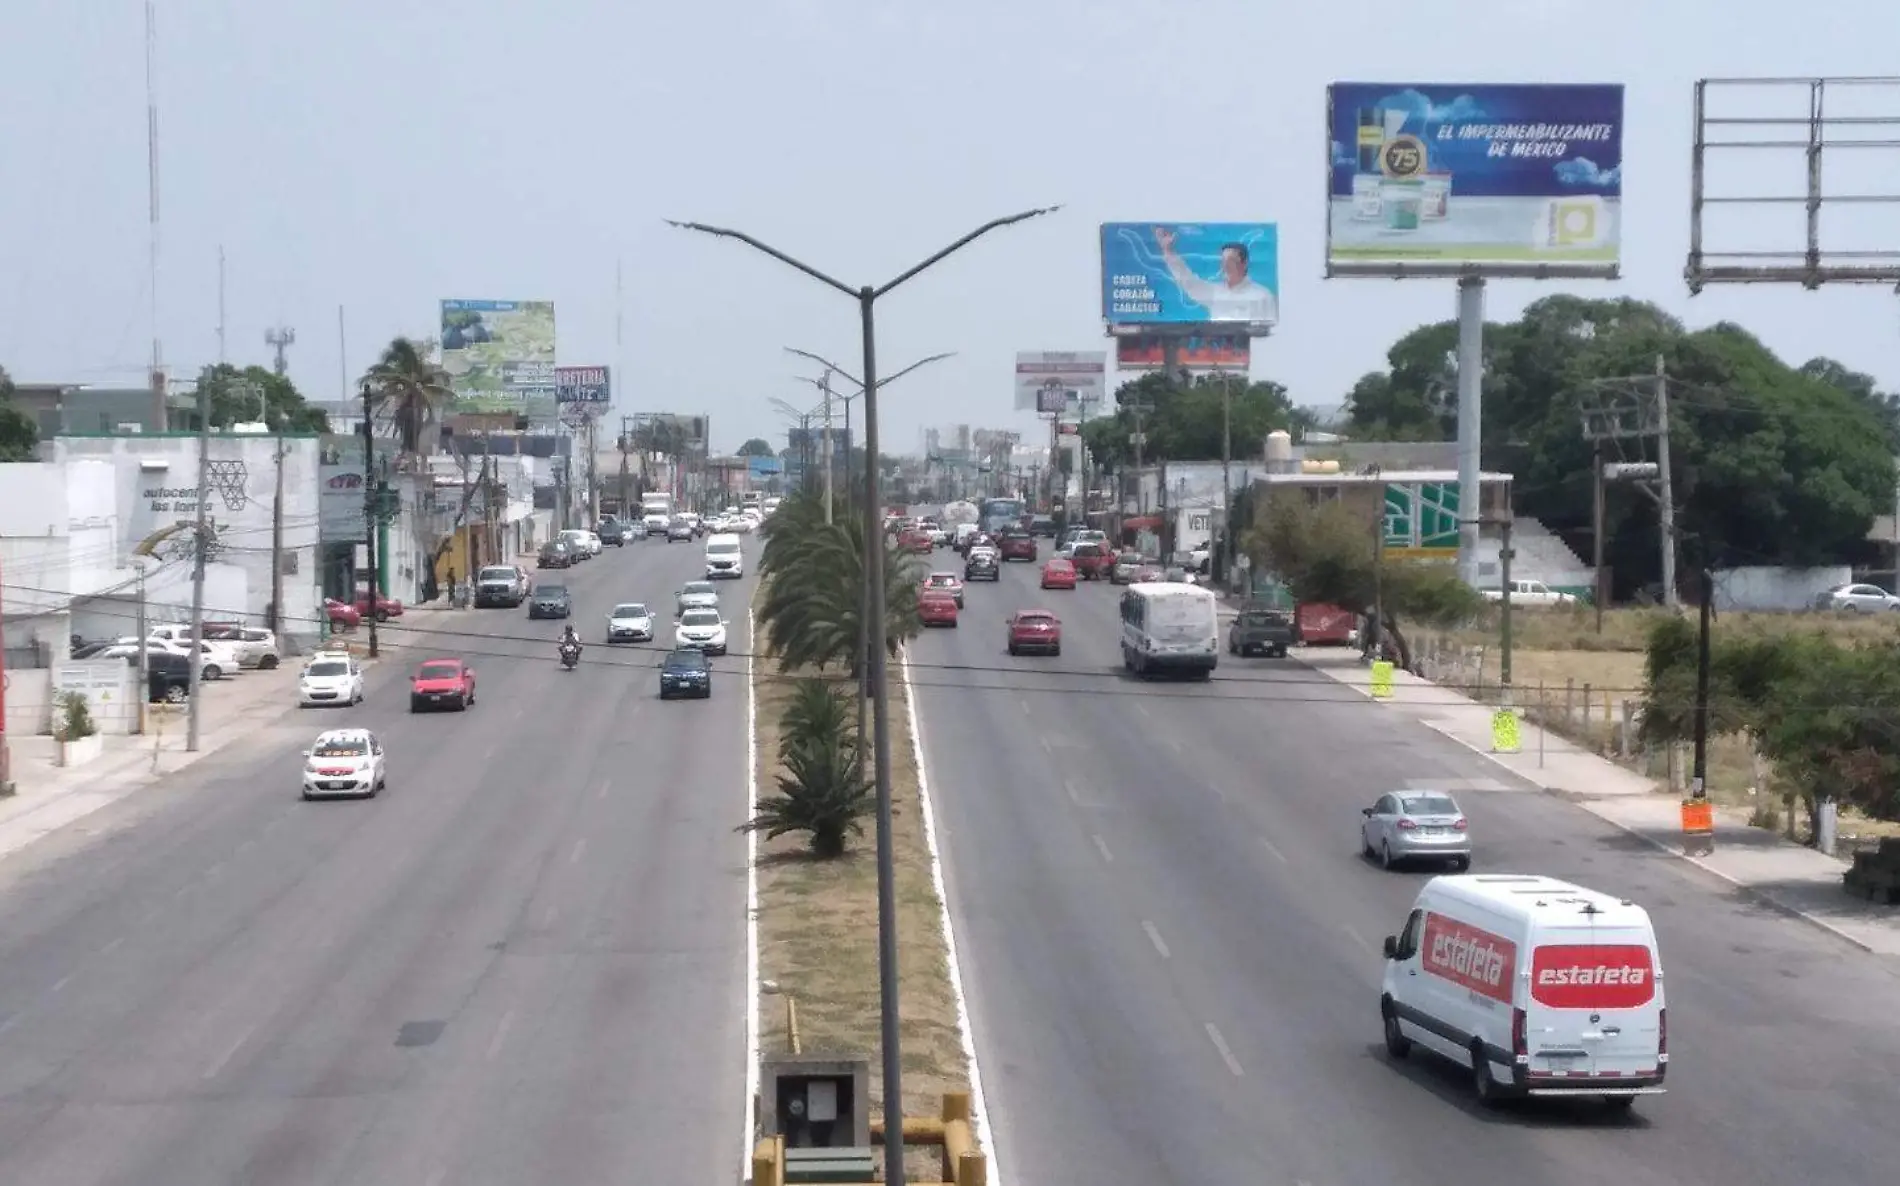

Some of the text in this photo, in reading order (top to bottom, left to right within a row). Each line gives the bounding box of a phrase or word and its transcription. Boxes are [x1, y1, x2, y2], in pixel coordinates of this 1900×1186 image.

[1437, 123, 1612, 141] EL IMPERMEABILIZANTE
[1393, 147, 1418, 167] 75
[1487, 142, 1507, 157] DE
[1432, 929, 1504, 987] estafeta
[1538, 964, 1645, 986] estafeta
